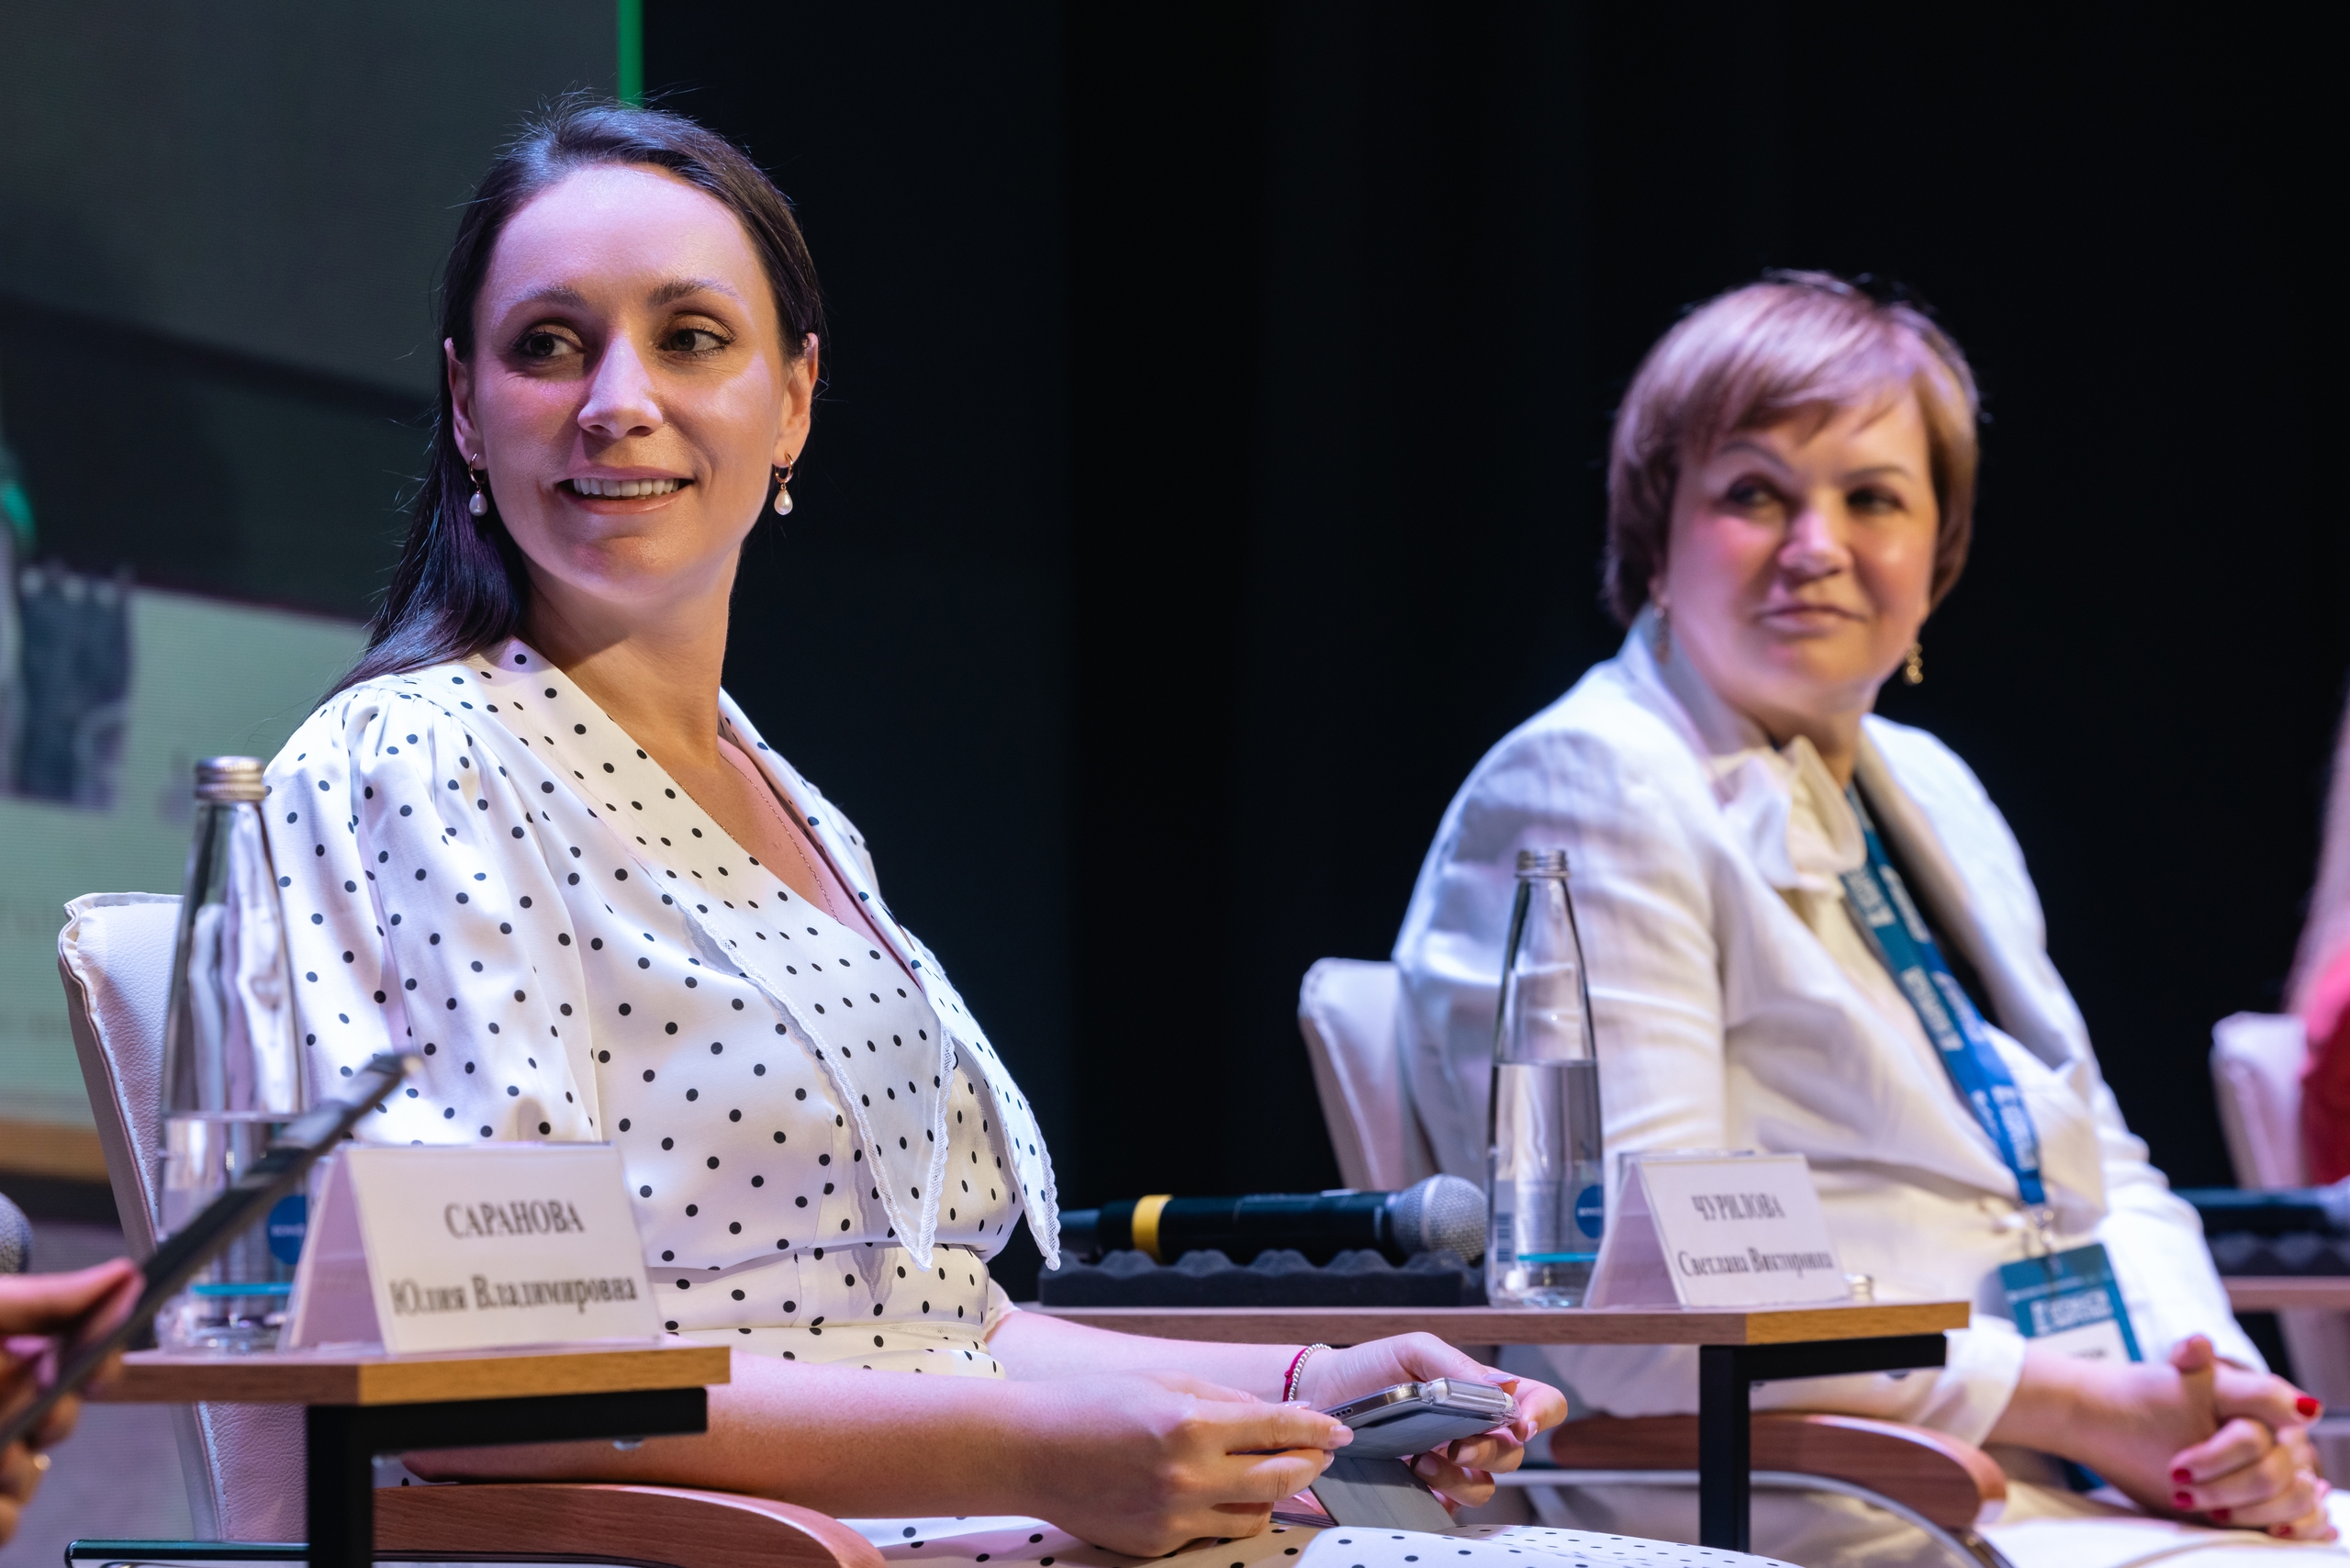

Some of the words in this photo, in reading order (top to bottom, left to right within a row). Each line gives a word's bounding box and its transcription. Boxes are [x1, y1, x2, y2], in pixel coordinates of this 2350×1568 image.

[444, 1200, 585, 1238] САРАНОВА
[389, 1278, 466, 1316] Юлия
[471, 1273, 638, 1314] Владимировна
